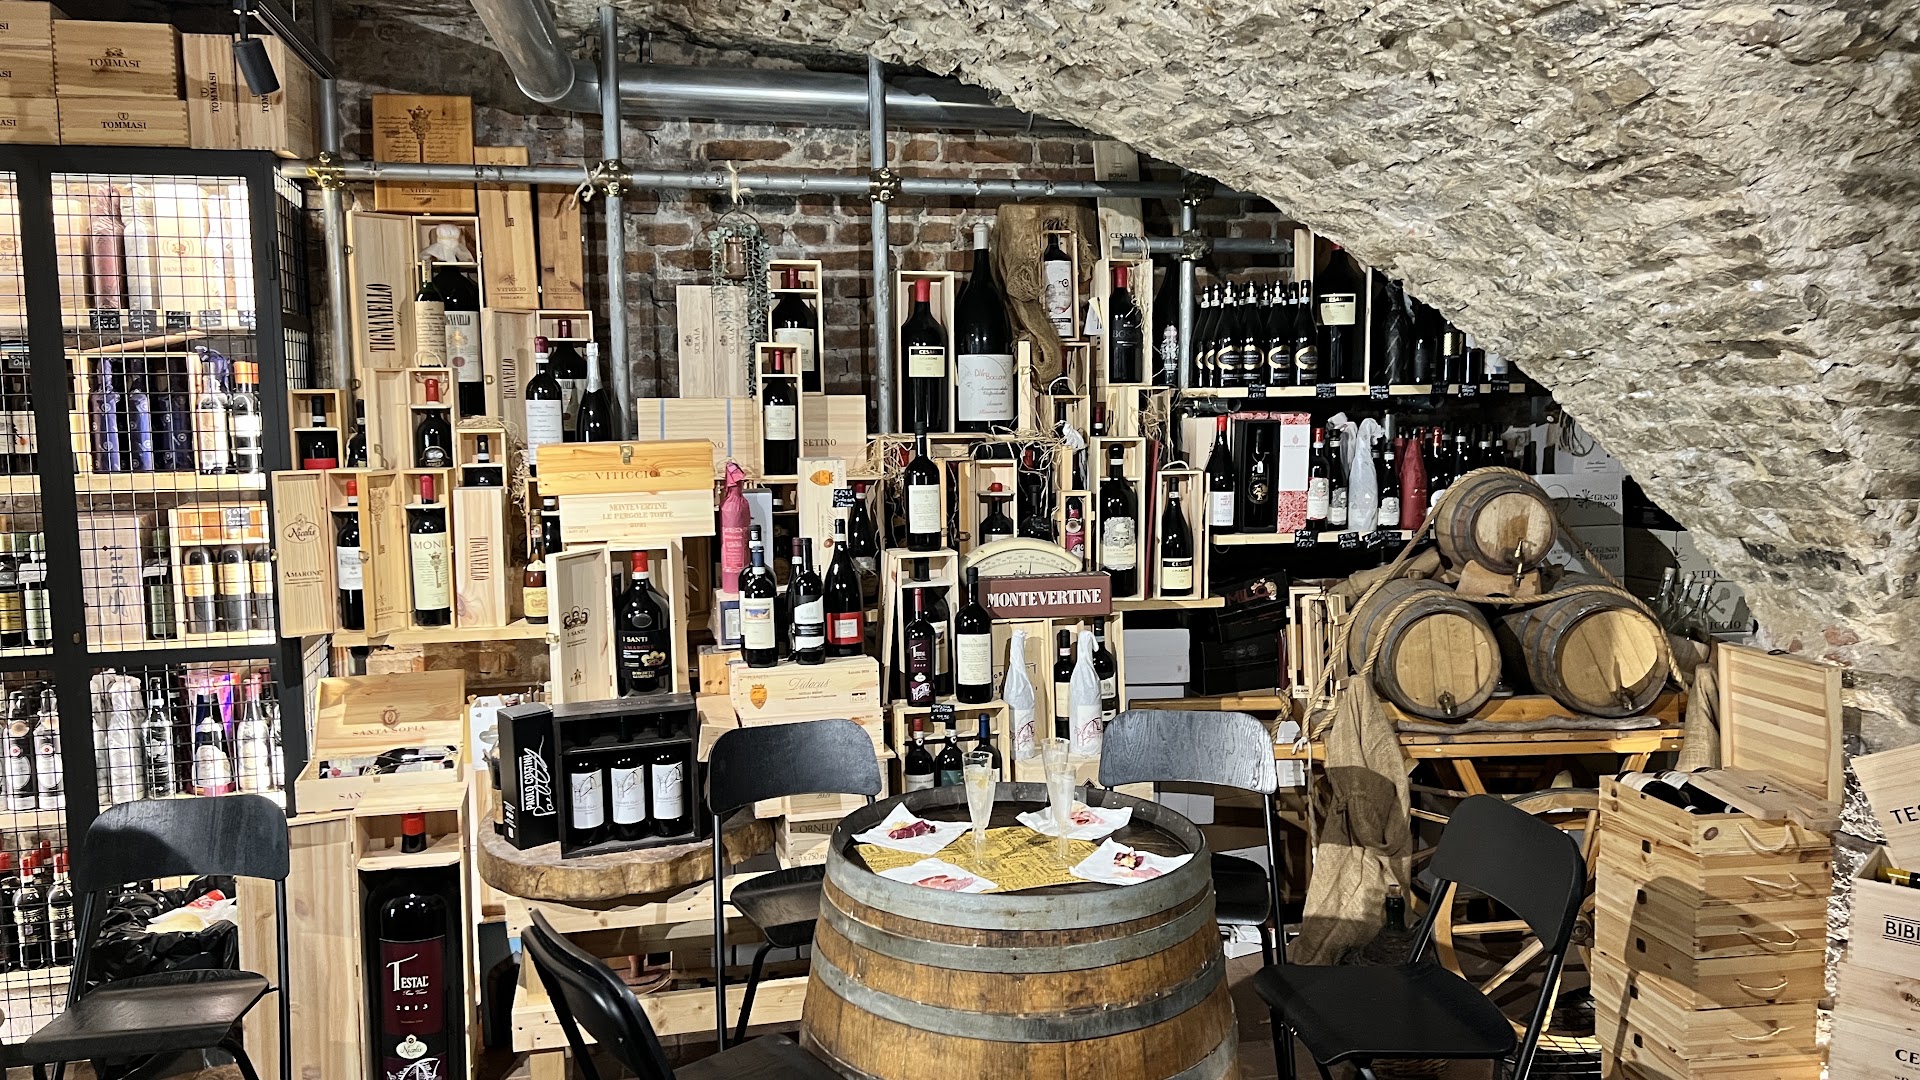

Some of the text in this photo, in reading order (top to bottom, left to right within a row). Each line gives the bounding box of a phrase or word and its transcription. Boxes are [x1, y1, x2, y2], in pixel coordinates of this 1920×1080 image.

[88, 58, 141, 67] TOMMASI
[208, 72, 219, 113] TOMMASI
[101, 121, 146, 129] TOMMASI
[366, 284, 395, 352] TIGNANELLO
[595, 470, 660, 480] VITICCIO
[609, 502, 668, 511] MONTEVERTINE
[987, 589, 1101, 607] MONTEVERTINE
[789, 677, 831, 690] Didacus
[352, 724, 427, 737] SANTA SOFIA
[338, 791, 366, 800] SAN
[524, 787, 536, 811] PAOLO
[386, 953, 429, 992] TESTAL
